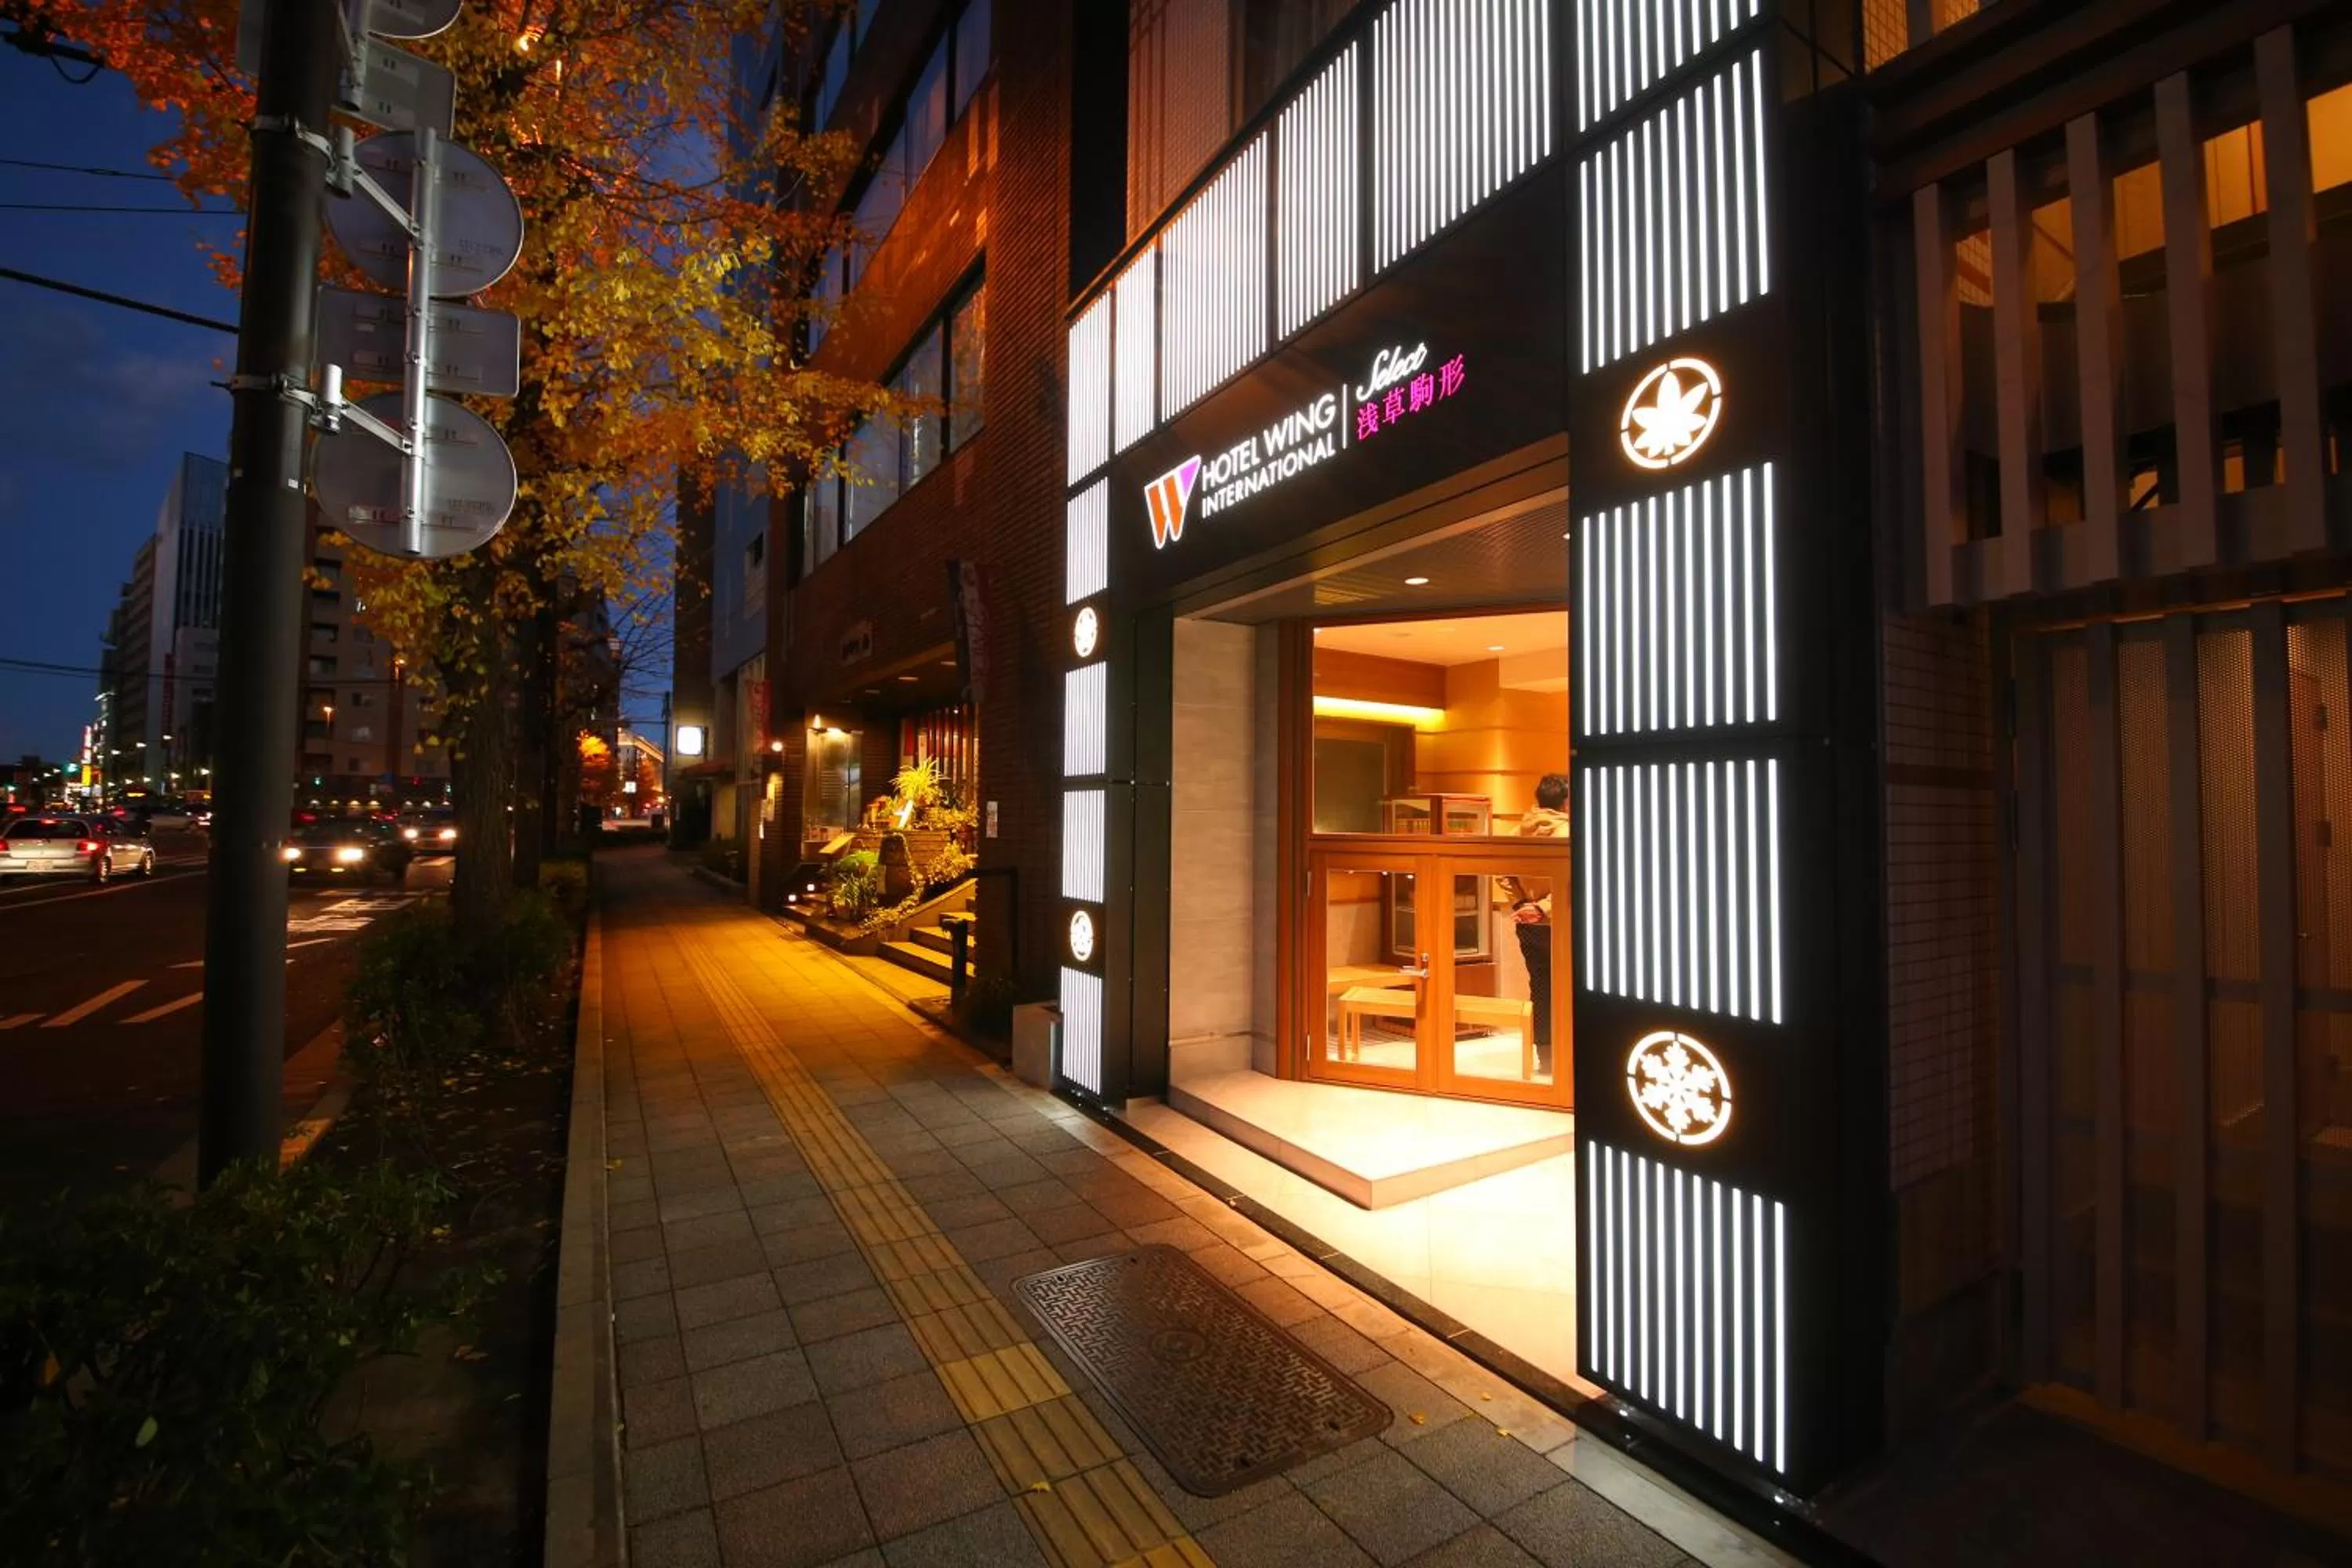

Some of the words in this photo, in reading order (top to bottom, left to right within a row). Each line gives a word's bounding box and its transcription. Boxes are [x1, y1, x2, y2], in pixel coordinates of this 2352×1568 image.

[1356, 342, 1428, 401] Select
[1356, 354, 1466, 441] 浅草駒形
[1201, 432, 1337, 519] INTERNATIONAL
[1202, 436, 1261, 492] HOTEL
[1264, 394, 1337, 453] WING
